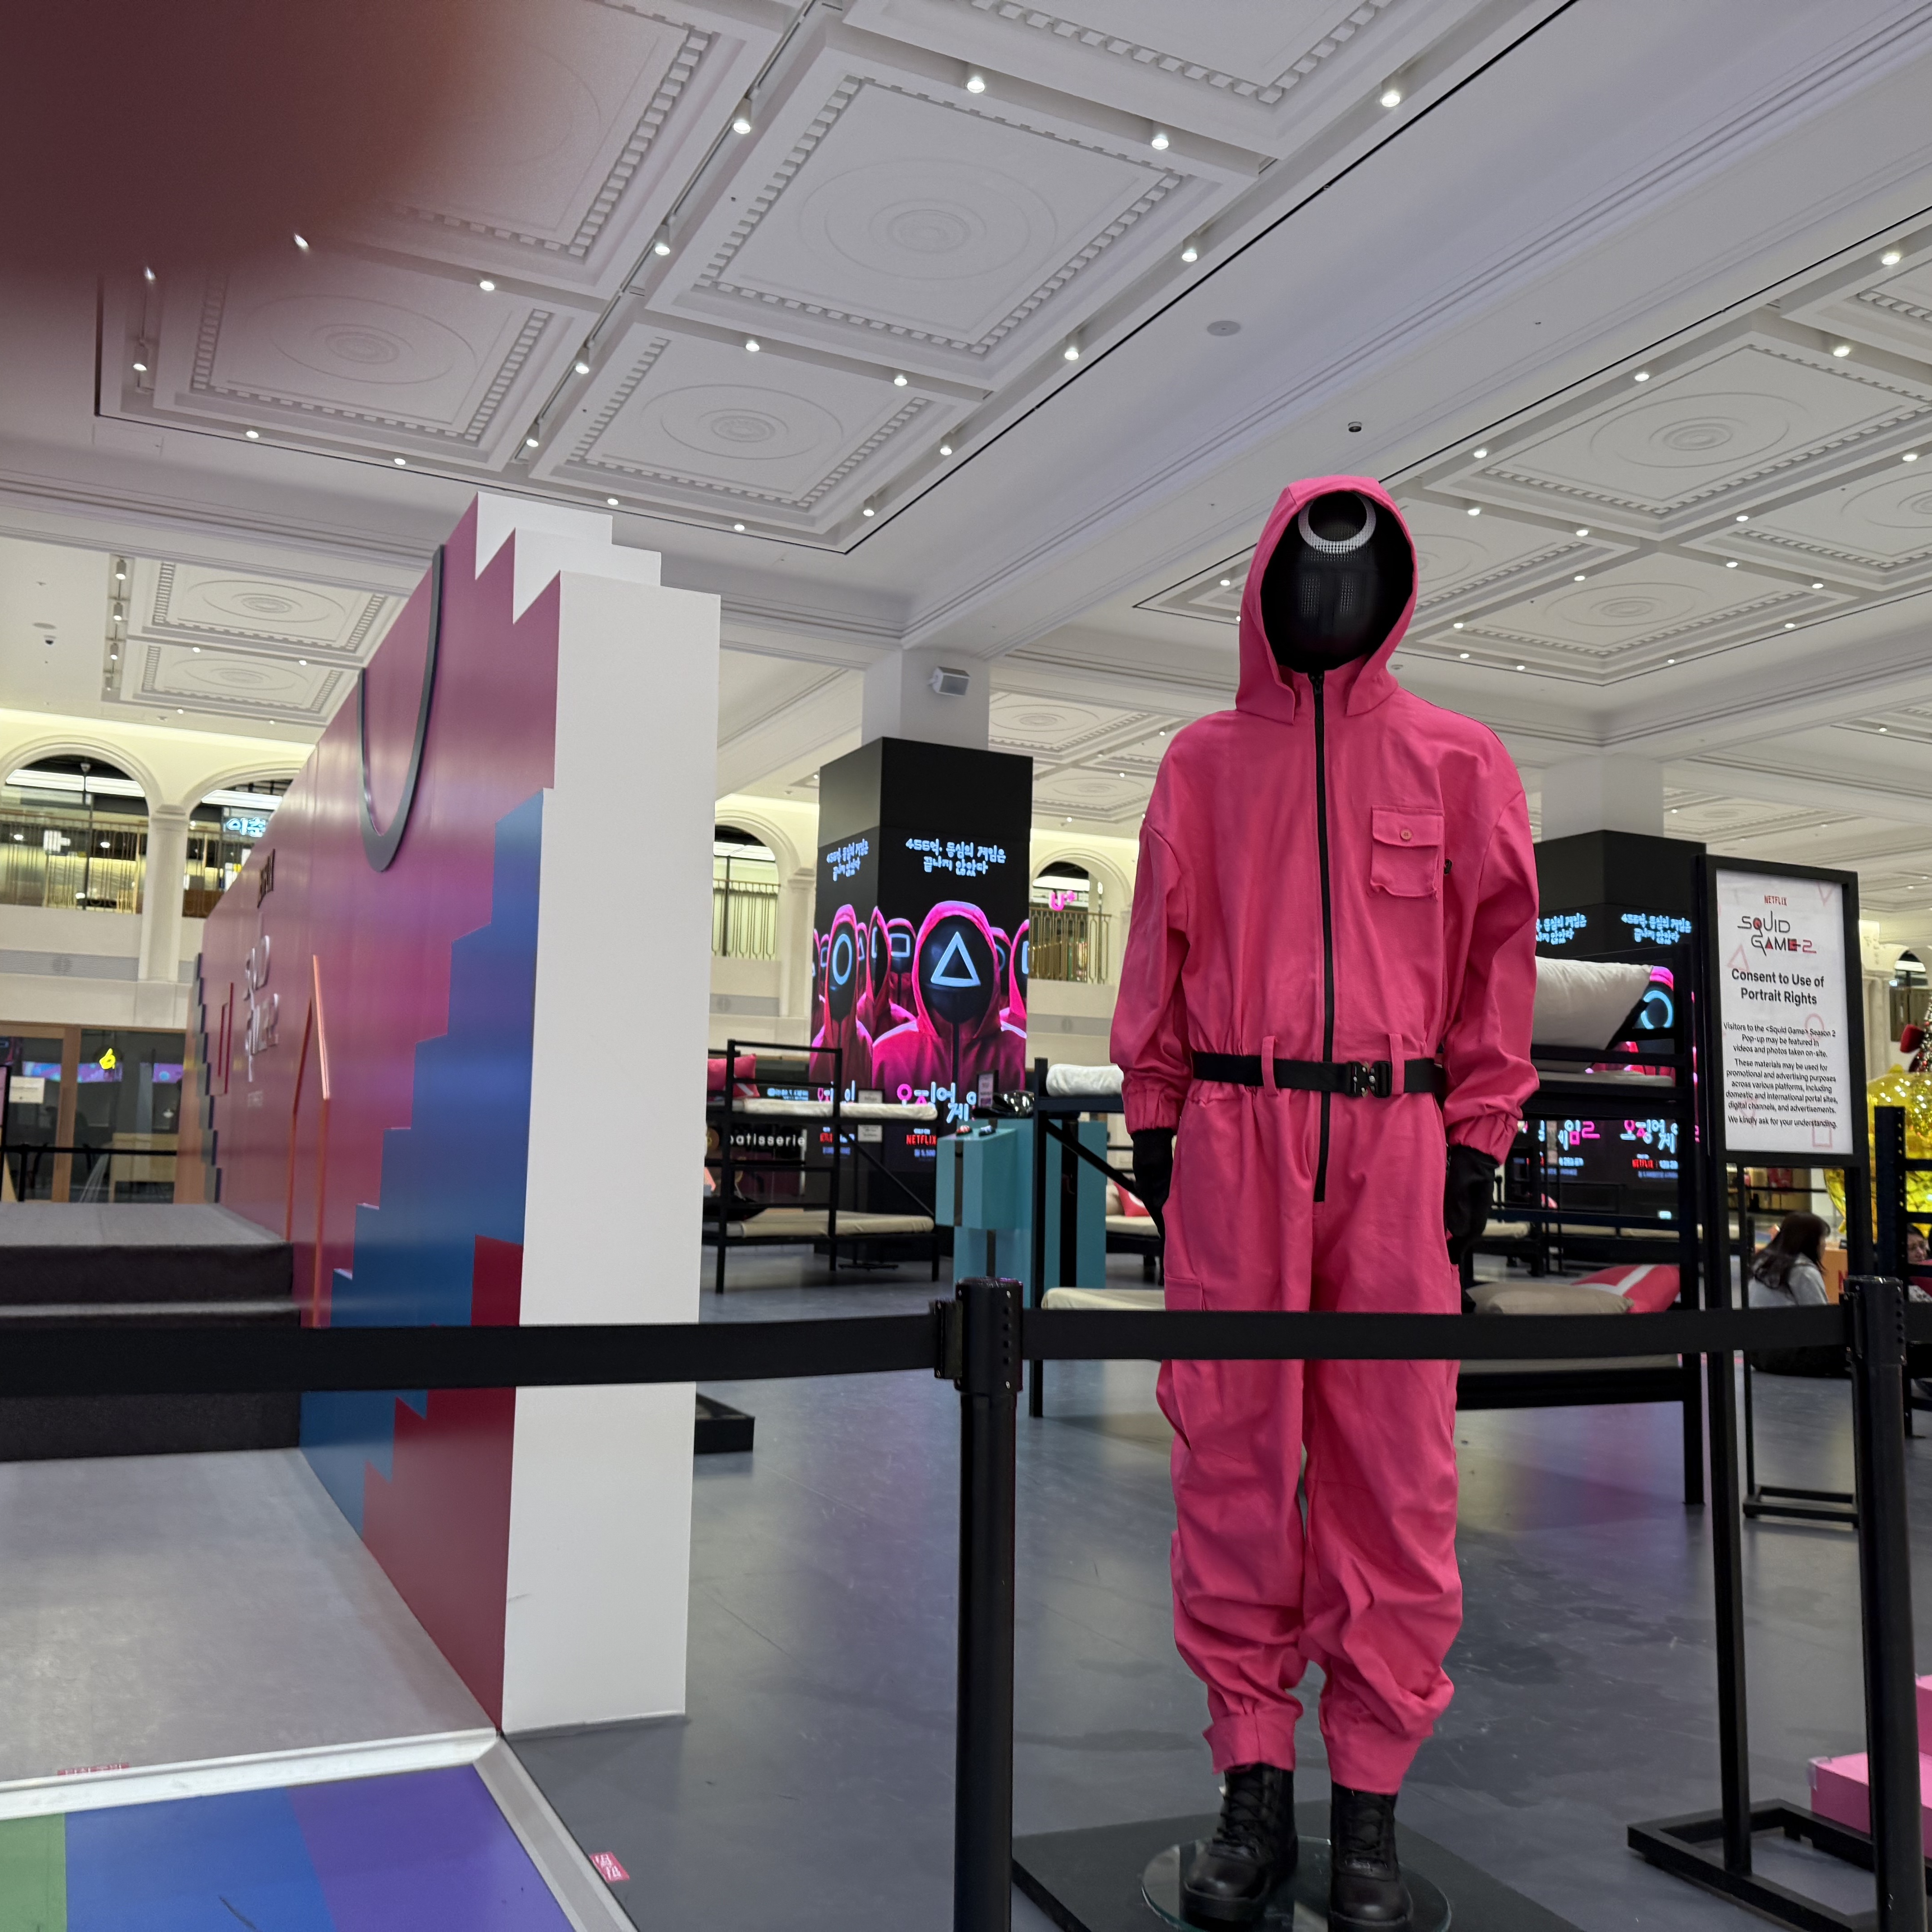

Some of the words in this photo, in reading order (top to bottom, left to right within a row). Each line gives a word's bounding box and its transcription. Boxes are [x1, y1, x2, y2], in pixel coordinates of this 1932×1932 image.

[1764, 895, 1787, 906] NETFLIX
[1737, 911, 1790, 934] SQUID
[1731, 968, 1776, 983] Consent
[1778, 972, 1789, 984] to
[1792, 973, 1811, 986] Use
[1814, 976, 1824, 987] of
[1741, 987, 1781, 1002] Portrait
[1784, 991, 1817, 1006] Rights
[1724, 1022, 1745, 1031] Visitors
[1755, 1024, 1764, 1033] the
[1810, 1028, 1831, 1037] Season
[1742, 1034, 1764, 1043] Pop-up
[1789, 1037, 1812, 1046] featured
[1814, 1039, 1819, 1047] in
[1733, 1044, 1753, 1052] videos
[1754, 1045, 1765, 1054] and
[1767, 1046, 1787, 1056] photos
[1734, 1058, 1753, 1067] These
[1755, 1060, 1781, 1068] materials
[1782, 1063, 1794, 1071] may
[1796, 1062, 1803, 1070] be
[1804, 1063, 1818, 1071] used
[1726, 1070, 1762, 1079] promotional
[1764, 1071, 1775, 1079] and
[1776, 1072, 1808, 1082] advertising
[1810, 1075, 1836, 1084] purposes
[1753, 1081, 1774, 1090] various
[1775, 1082, 1804, 1092] platforms,
[1806, 1084, 1832, 1094] including
[1726, 1090, 1753, 1099] domestic
[1755, 1091, 1766, 1100] and
[1767, 1092, 1804, 1102] international
[1805, 1094, 1822, 1104] portal
[1729, 1100, 1747, 1110] digital
[1748, 1103, 1776, 1112] channels,
[1778, 1103, 1789, 1112] and
[1728, 1115, 1738, 1124] We
[1739, 1116, 1757, 1126] kindly
[1759, 1117, 1769, 1125] ask
[1780, 1119, 1793, 1128] your
[906, 1134, 937, 1145] NETFLIX
